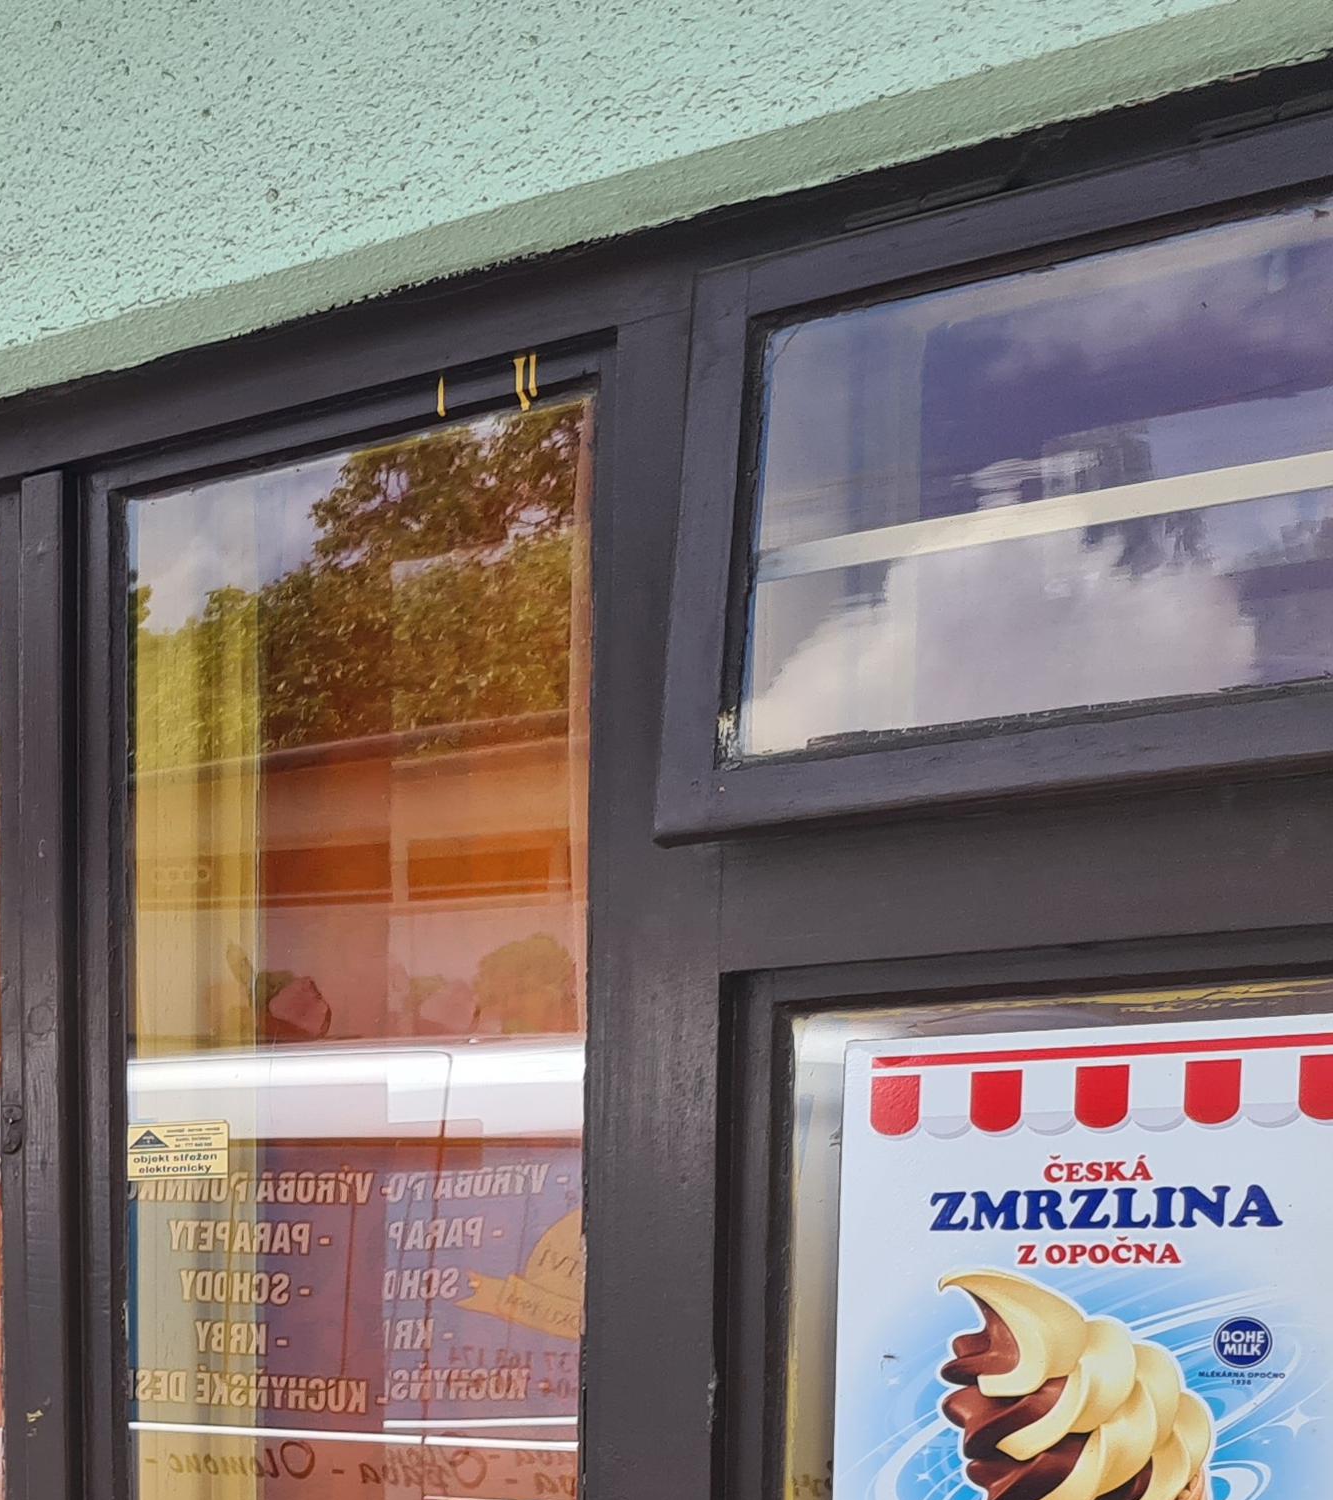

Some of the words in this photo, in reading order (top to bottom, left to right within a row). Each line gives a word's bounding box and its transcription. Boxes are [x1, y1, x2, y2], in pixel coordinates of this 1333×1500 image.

[133, 1155, 170, 1164] objekt
[138, 1164, 212, 1174] elektronicky
[1043, 1154, 1154, 1183] ČESKÁ
[929, 1184, 1284, 1232] ZMRZLINA
[1017, 1243, 1038, 1265] Z
[1044, 1236, 1182, 1265] OPOČNA
[1220, 1330, 1265, 1343] BOHE
[1223, 1343, 1261, 1356] MILK
[1247, 1371, 1286, 1379] OPOČNO
